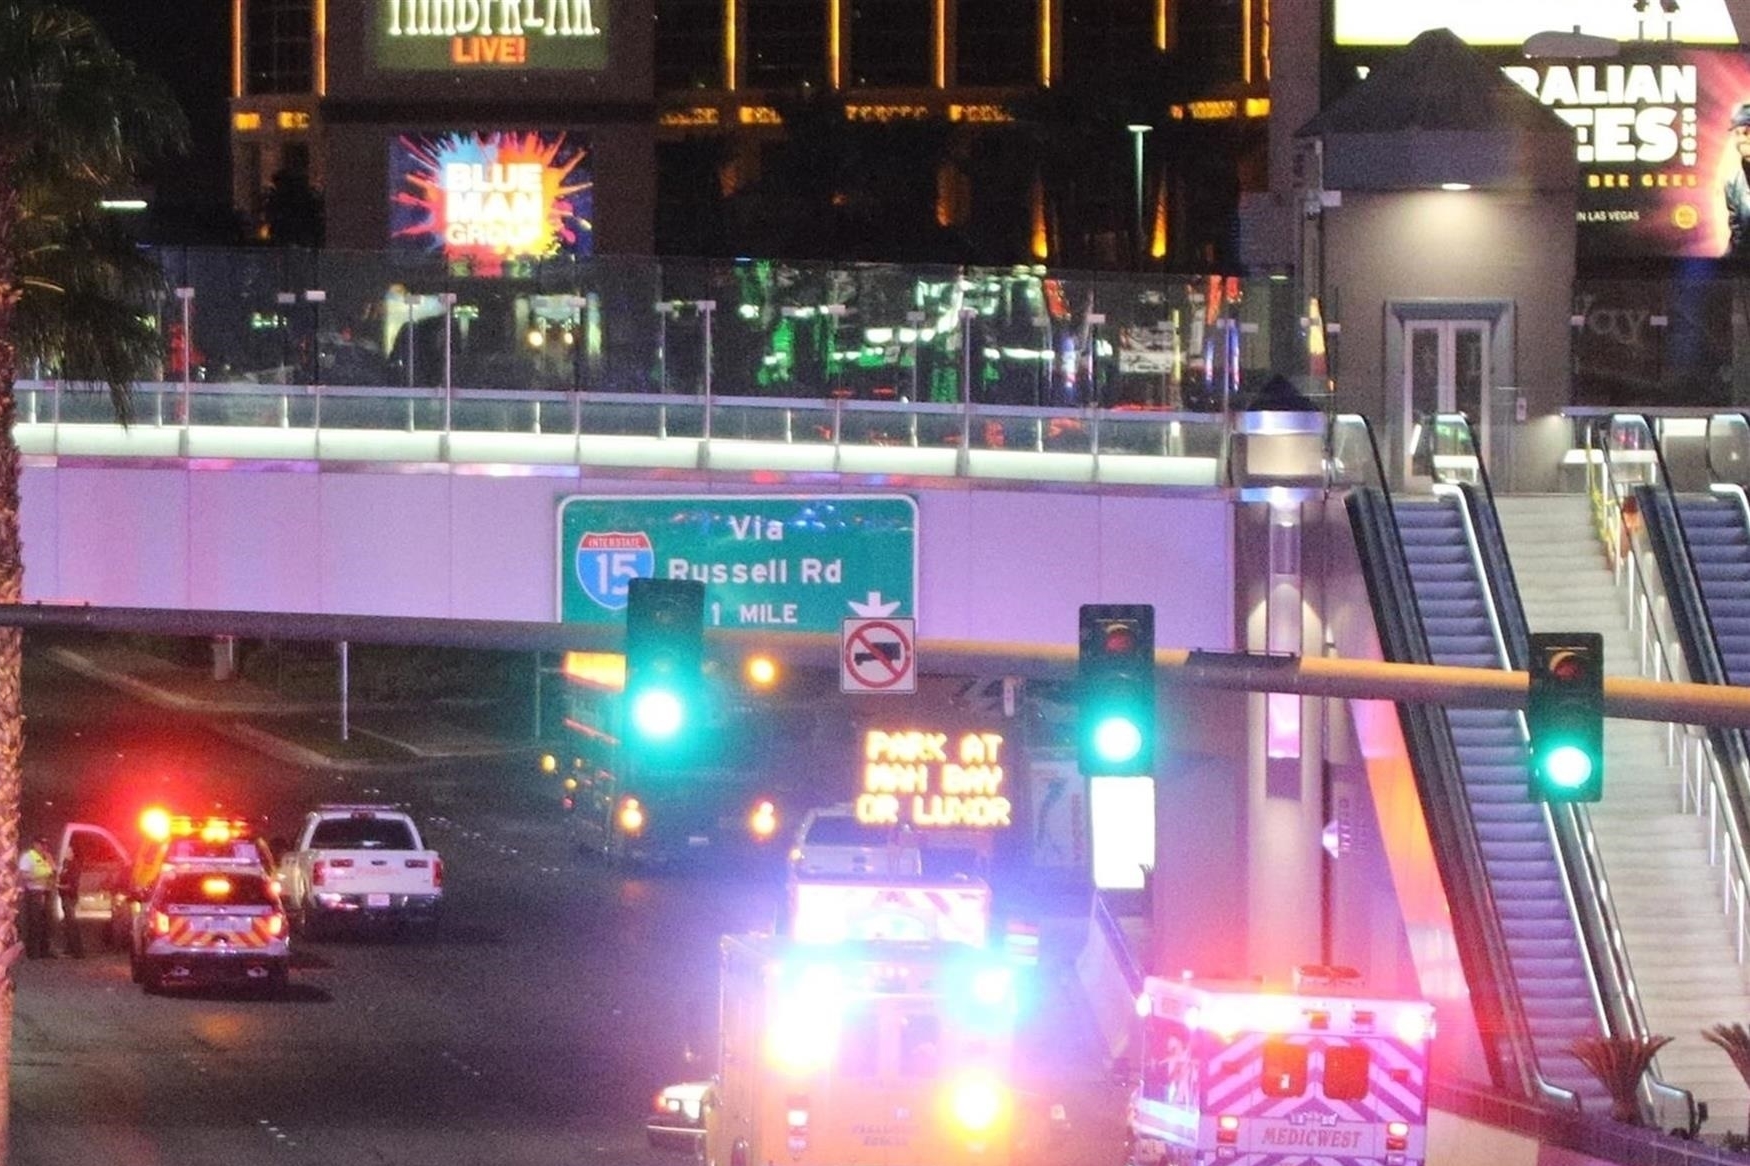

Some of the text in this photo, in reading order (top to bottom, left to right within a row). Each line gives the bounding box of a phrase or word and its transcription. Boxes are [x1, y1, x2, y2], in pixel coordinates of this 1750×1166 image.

[453, 37, 526, 63] LIVE!
[446, 163, 543, 192] BLUE
[446, 192, 543, 222] MAN
[1588, 211, 1606, 222] LAS
[1607, 211, 1640, 222] VEGAS
[446, 222, 539, 246] GROUP
[731, 515, 784, 541] Via
[588, 536, 643, 549] INTERSTATE
[596, 552, 639, 596] 15
[668, 558, 843, 585] Russell Rd
[711, 602, 798, 626] 1 MILE
[865, 730, 1003, 764] PARK AT
[856, 793, 1012, 826] OR LUXOR
[1261, 1127, 1362, 1148] MEDICWEST
